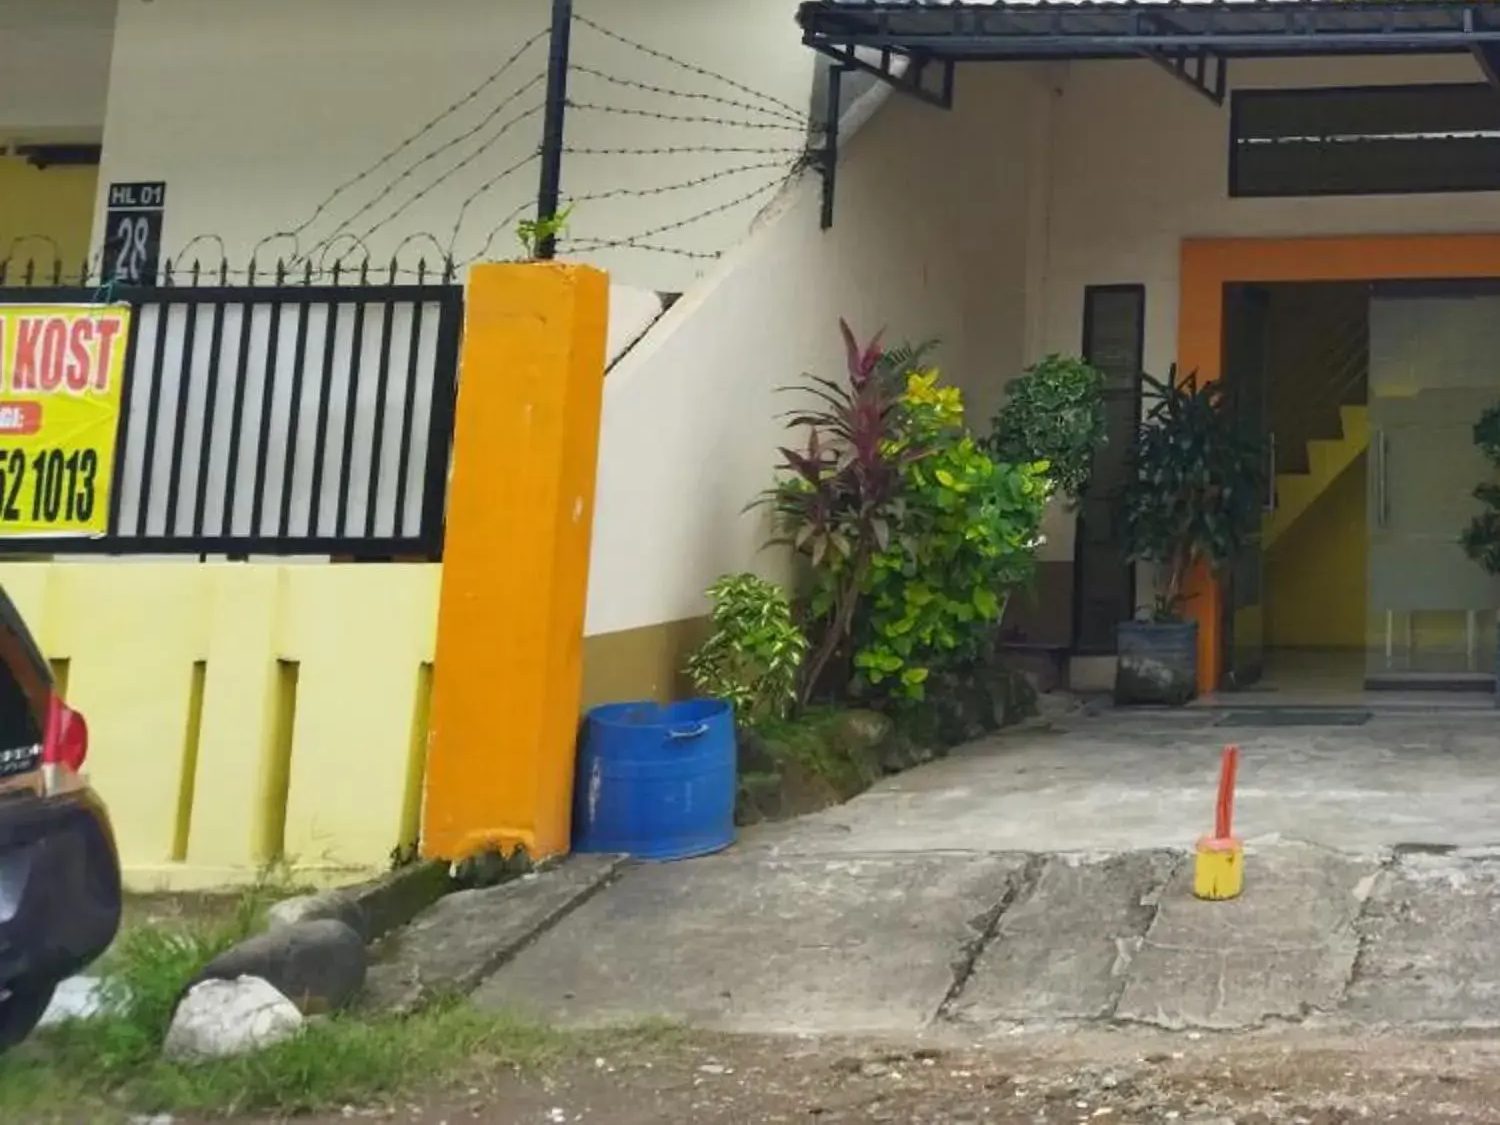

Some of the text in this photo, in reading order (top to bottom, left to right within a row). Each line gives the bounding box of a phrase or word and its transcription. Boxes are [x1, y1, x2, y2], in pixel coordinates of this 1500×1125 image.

[111, 186, 137, 204] HL
[115, 216, 150, 281] 28
[12, 316, 121, 392] KOST
[32, 448, 98, 523] 1013
